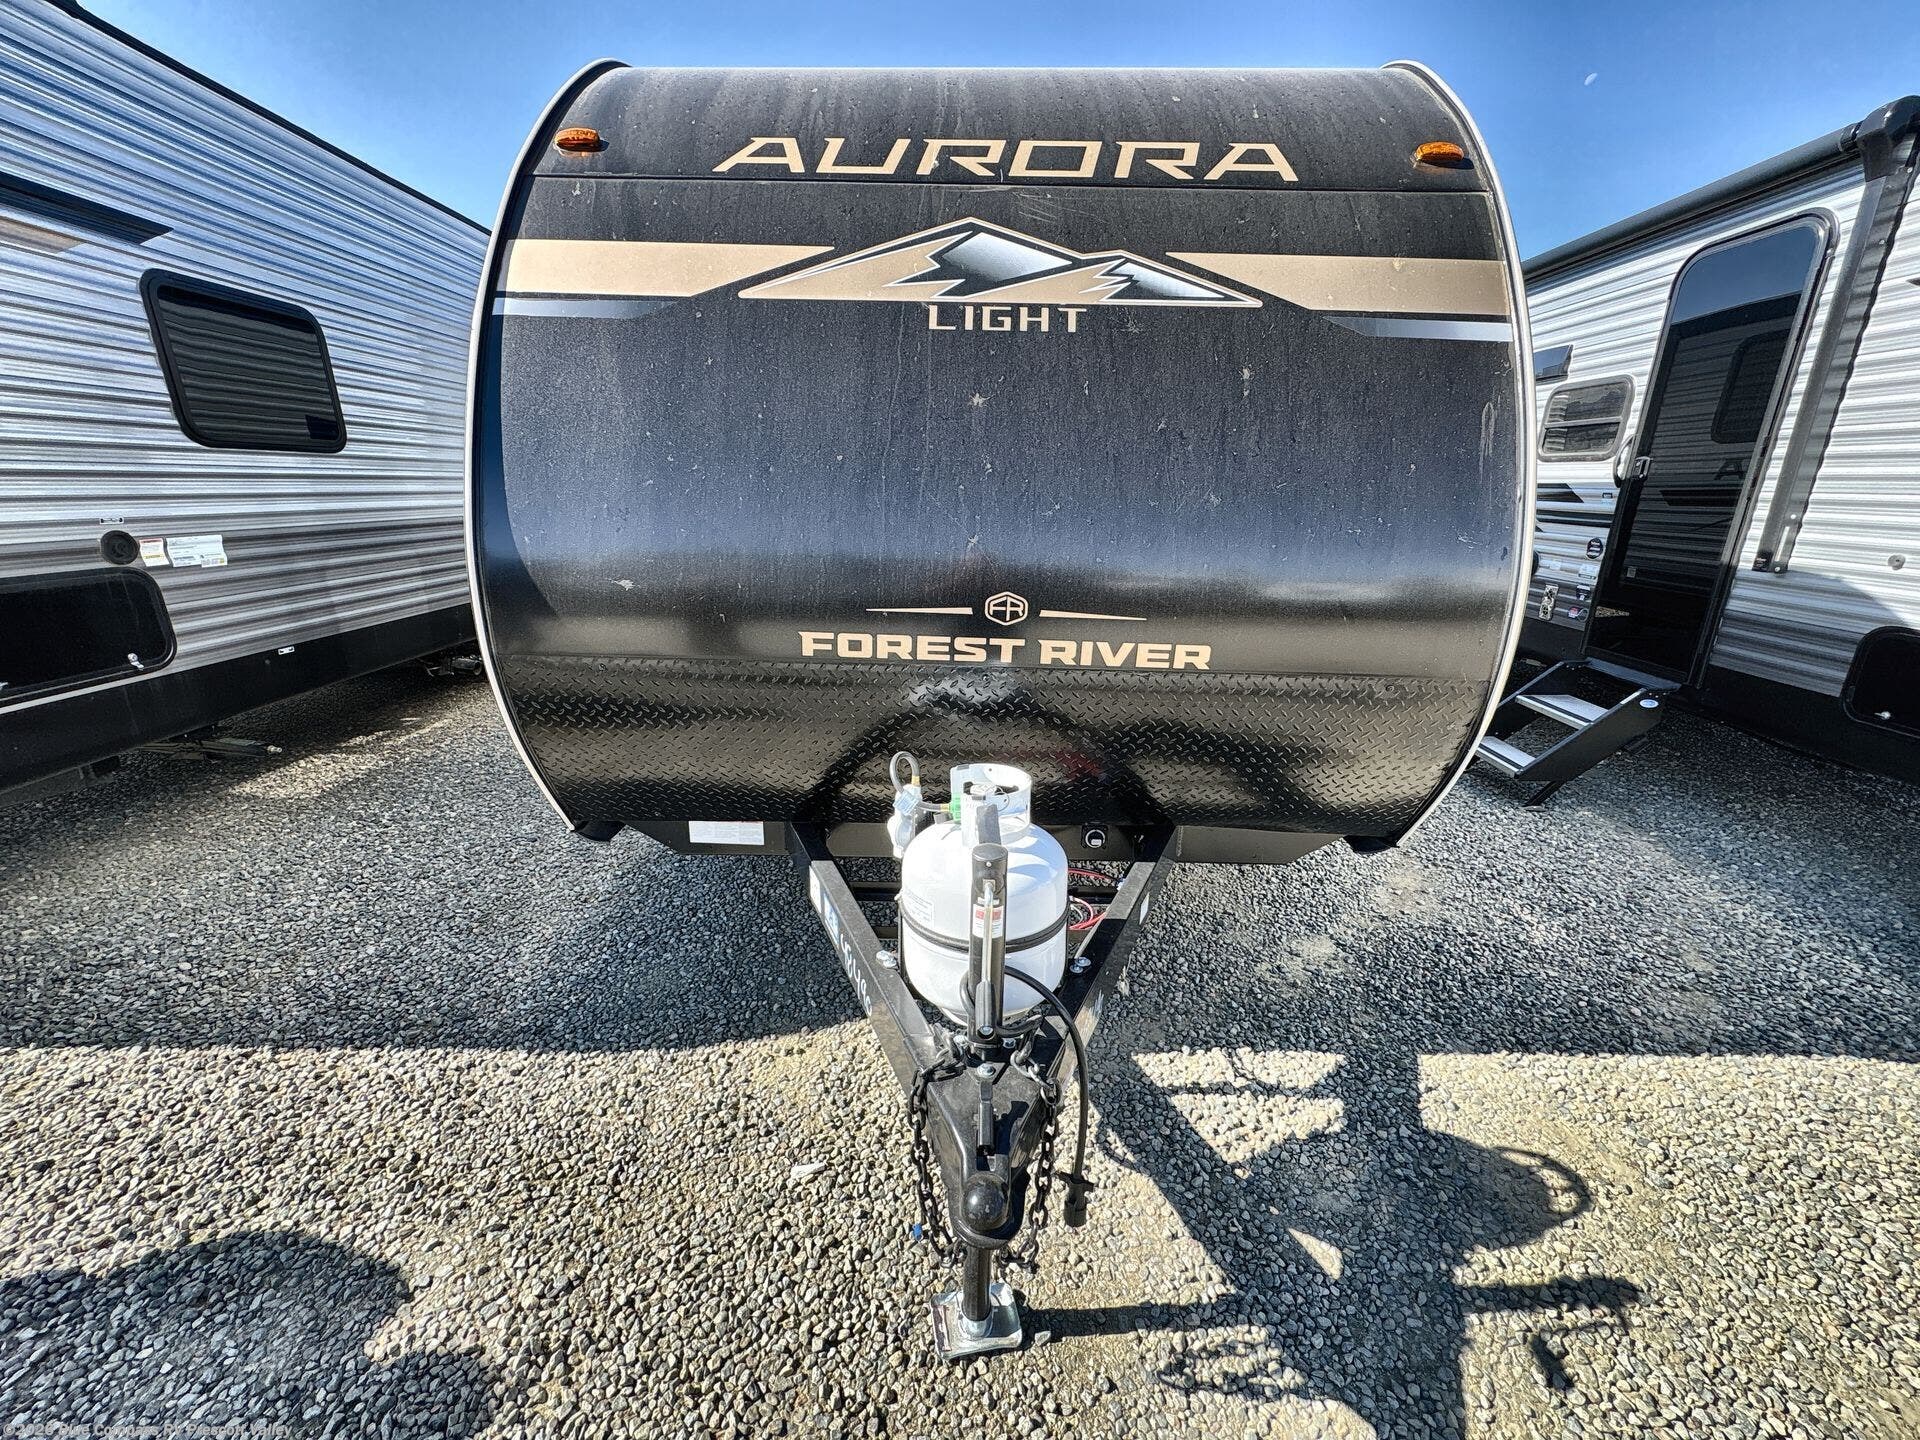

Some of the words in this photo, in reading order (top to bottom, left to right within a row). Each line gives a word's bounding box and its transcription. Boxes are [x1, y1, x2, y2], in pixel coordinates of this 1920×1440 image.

[712, 137, 1298, 182] AURORA
[928, 304, 1087, 332] LIGHT
[989, 596, 1024, 622] FR
[798, 631, 1026, 663] FOREST
[1038, 639, 1212, 670] RIVER
